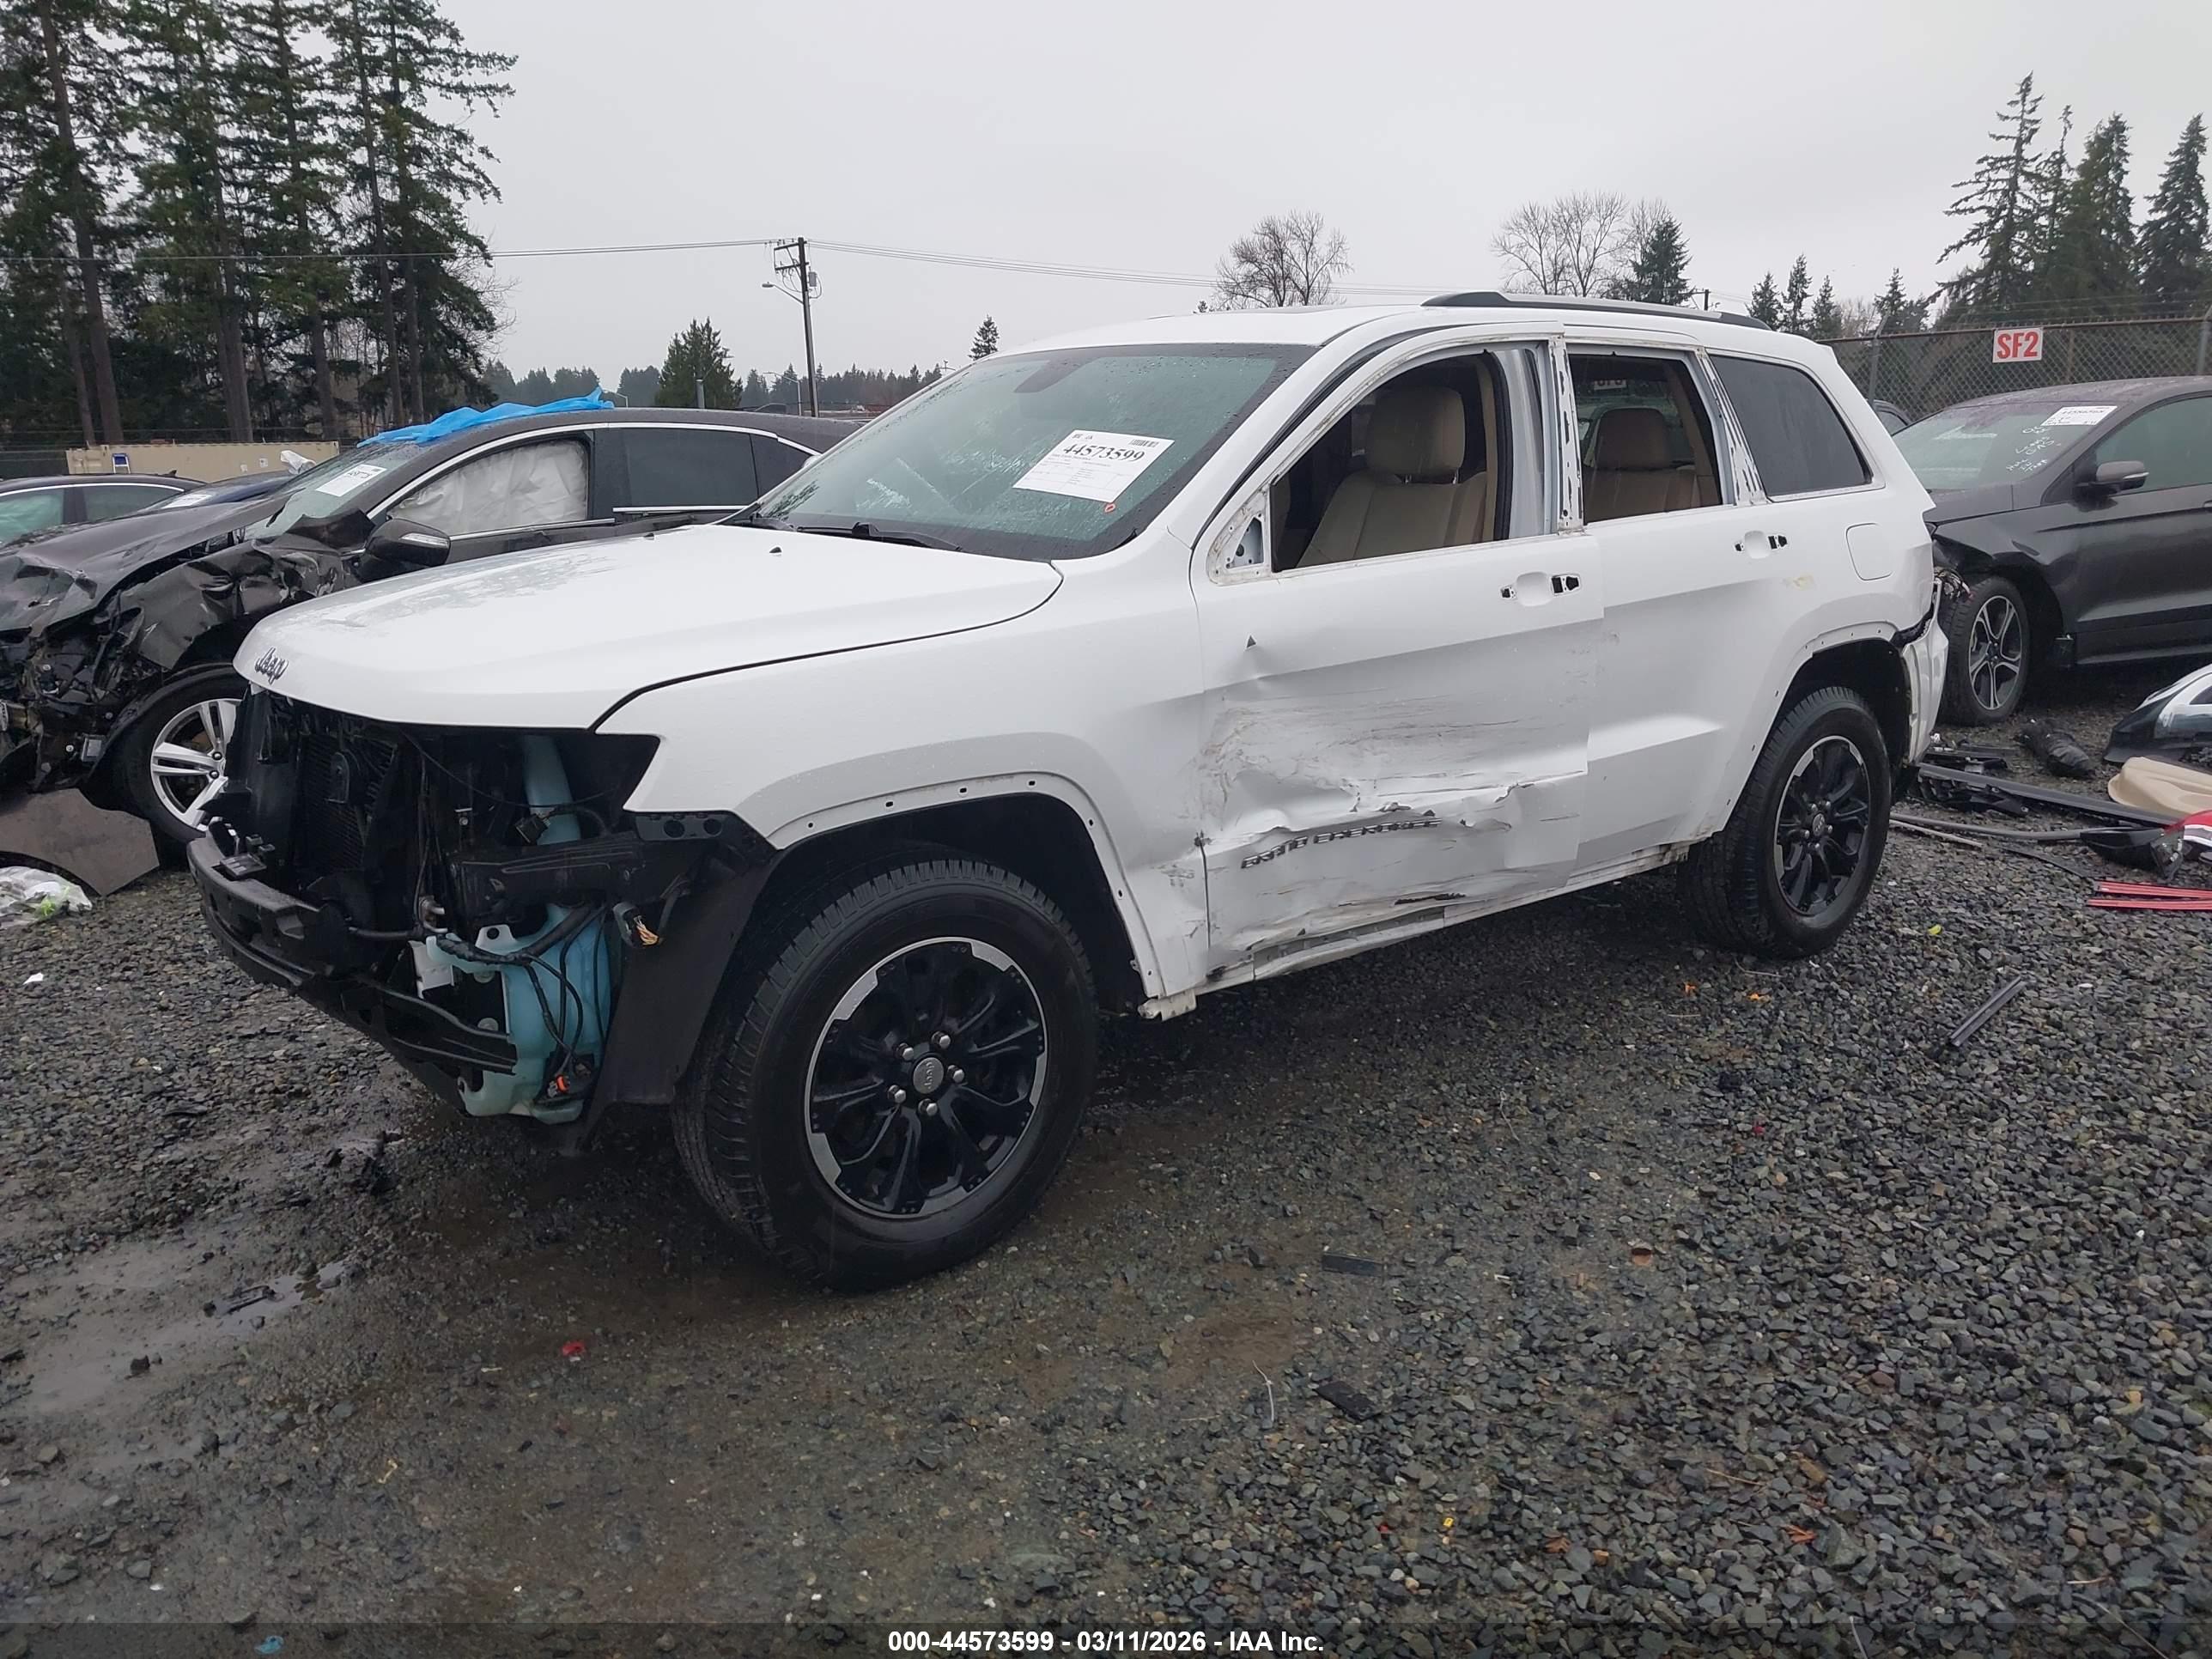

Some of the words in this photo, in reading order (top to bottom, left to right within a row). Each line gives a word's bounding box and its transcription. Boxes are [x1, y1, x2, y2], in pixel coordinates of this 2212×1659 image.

[1997, 331, 2039, 359] SF2
[1063, 443, 1145, 462] 44573599
[255, 647, 289, 684] Jeep
